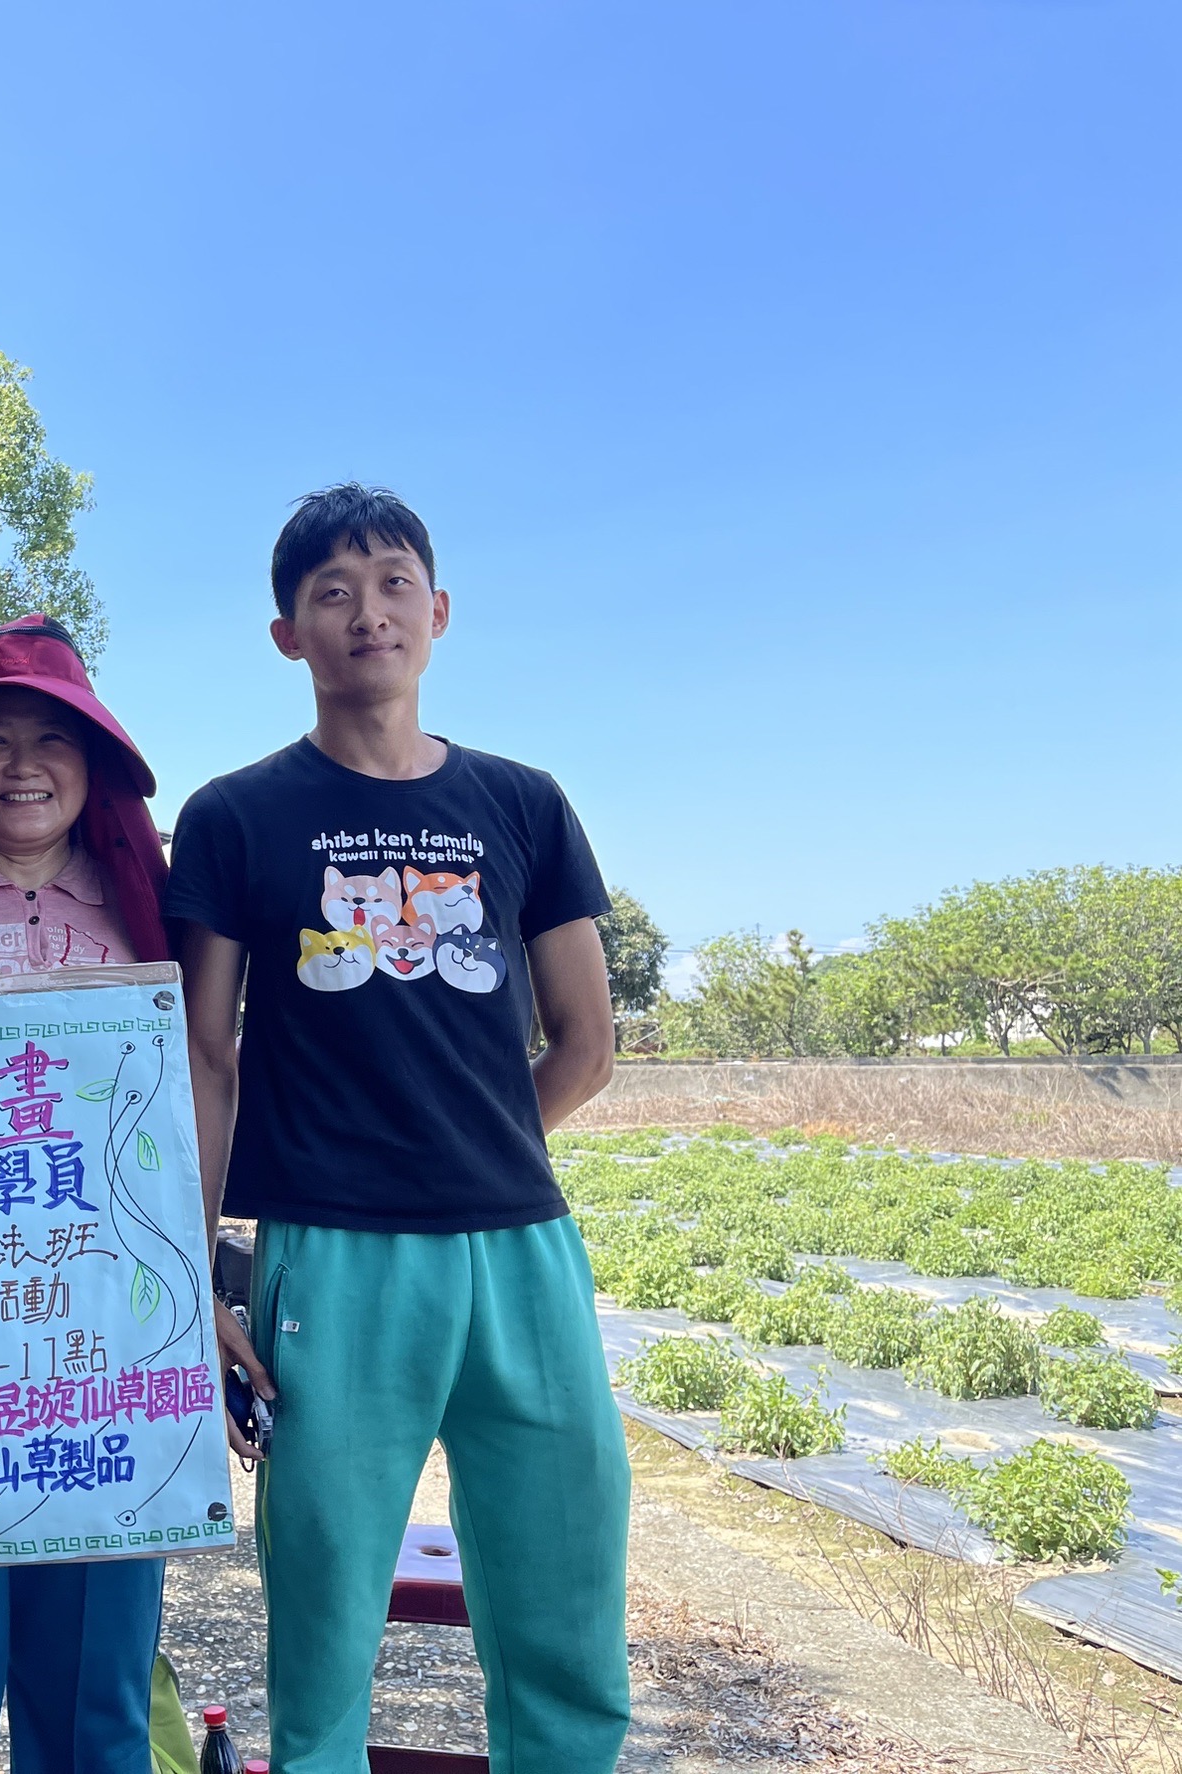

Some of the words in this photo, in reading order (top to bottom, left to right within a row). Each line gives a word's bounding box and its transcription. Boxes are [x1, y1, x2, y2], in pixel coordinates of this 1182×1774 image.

[311, 830, 369, 851] shiba
[374, 828, 414, 847] ken
[420, 829, 484, 857] family
[329, 850, 379, 862] kawaii
[383, 850, 406, 860] inu
[411, 848, 475, 863] together
